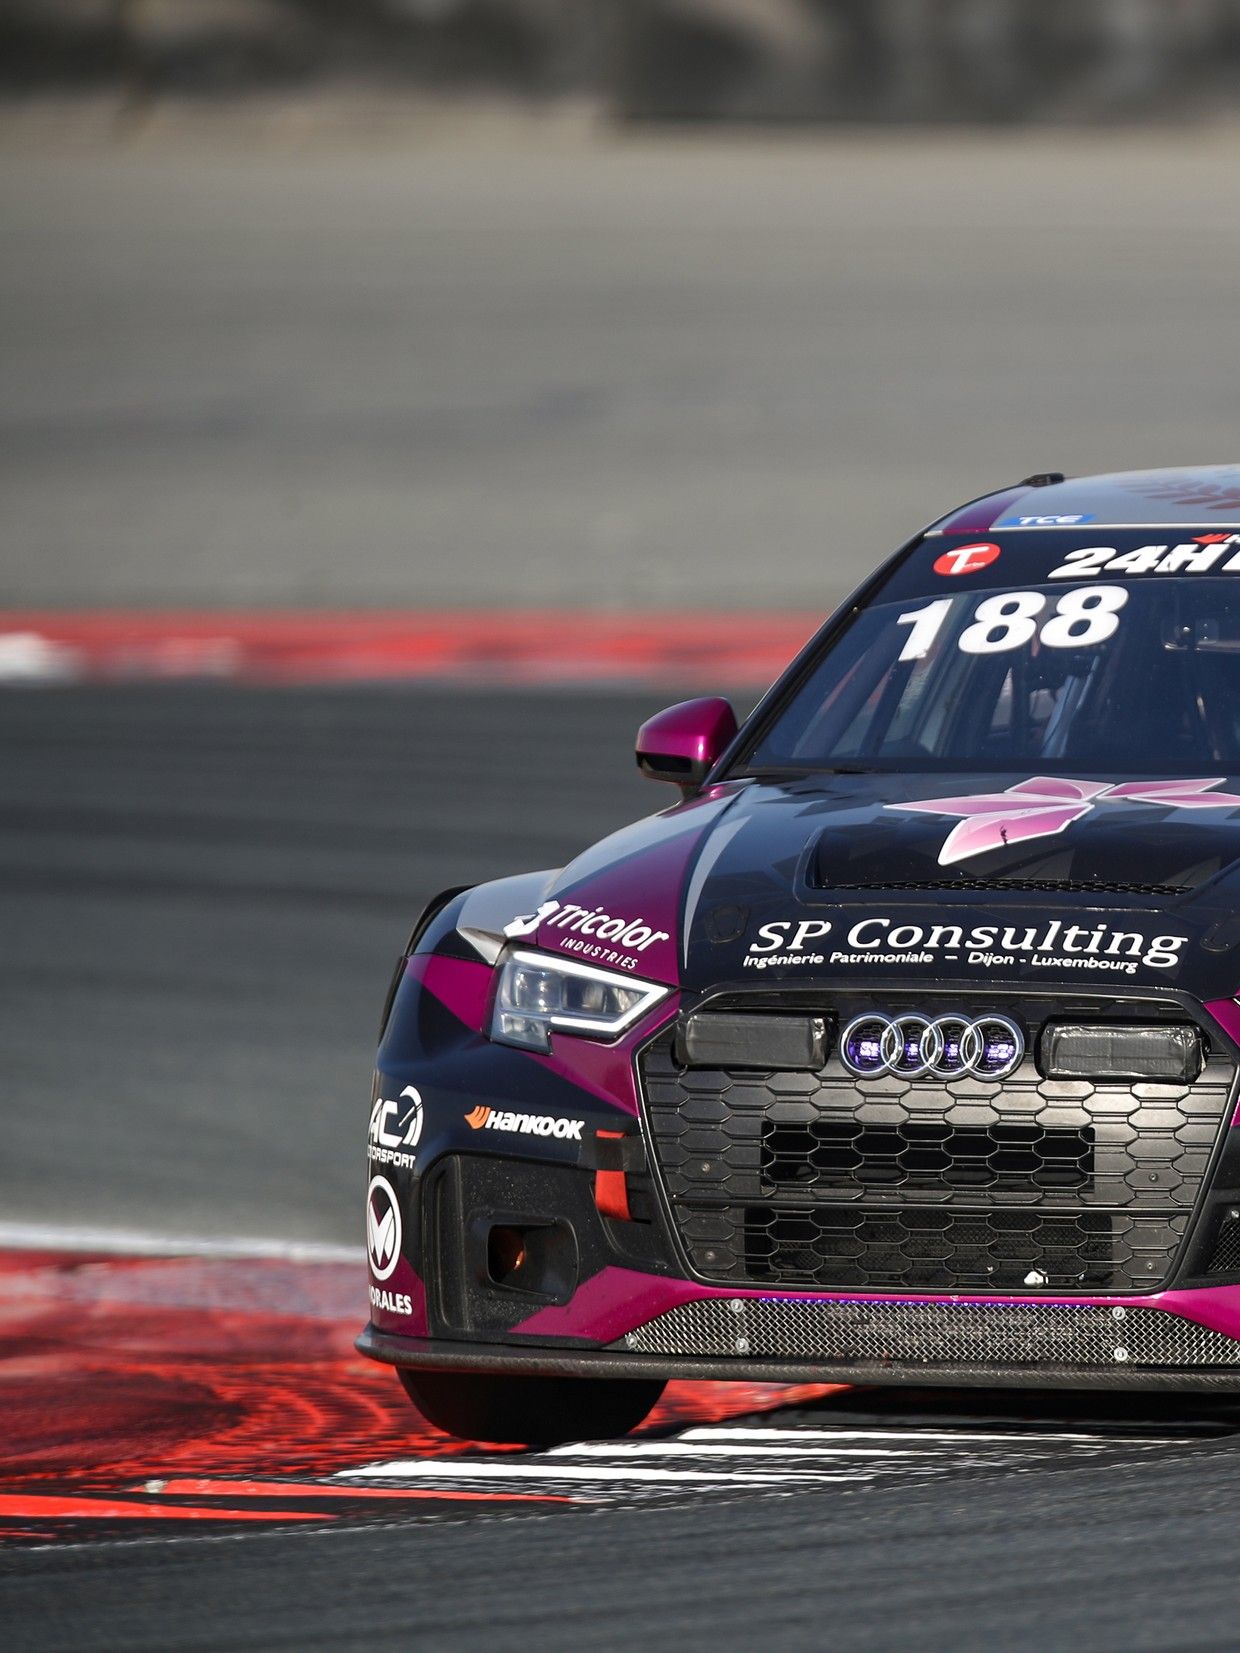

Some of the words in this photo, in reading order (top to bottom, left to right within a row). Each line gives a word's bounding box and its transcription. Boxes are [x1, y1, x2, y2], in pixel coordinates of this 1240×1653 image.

[1018, 515, 1084, 525] TCE
[1047, 544, 1231, 579] 24H
[896, 585, 1129, 663] 188
[559, 937, 639, 970] INDUSTRIES
[749, 920, 832, 951] SP
[847, 918, 1189, 968] Consulting
[743, 952, 824, 969] Ingénierie
[829, 951, 934, 964] Patrimoniale
[967, 952, 1015, 967] Dijon
[1031, 954, 1139, 974] Luxembourg
[369, 1285, 413, 1315] ORALES
